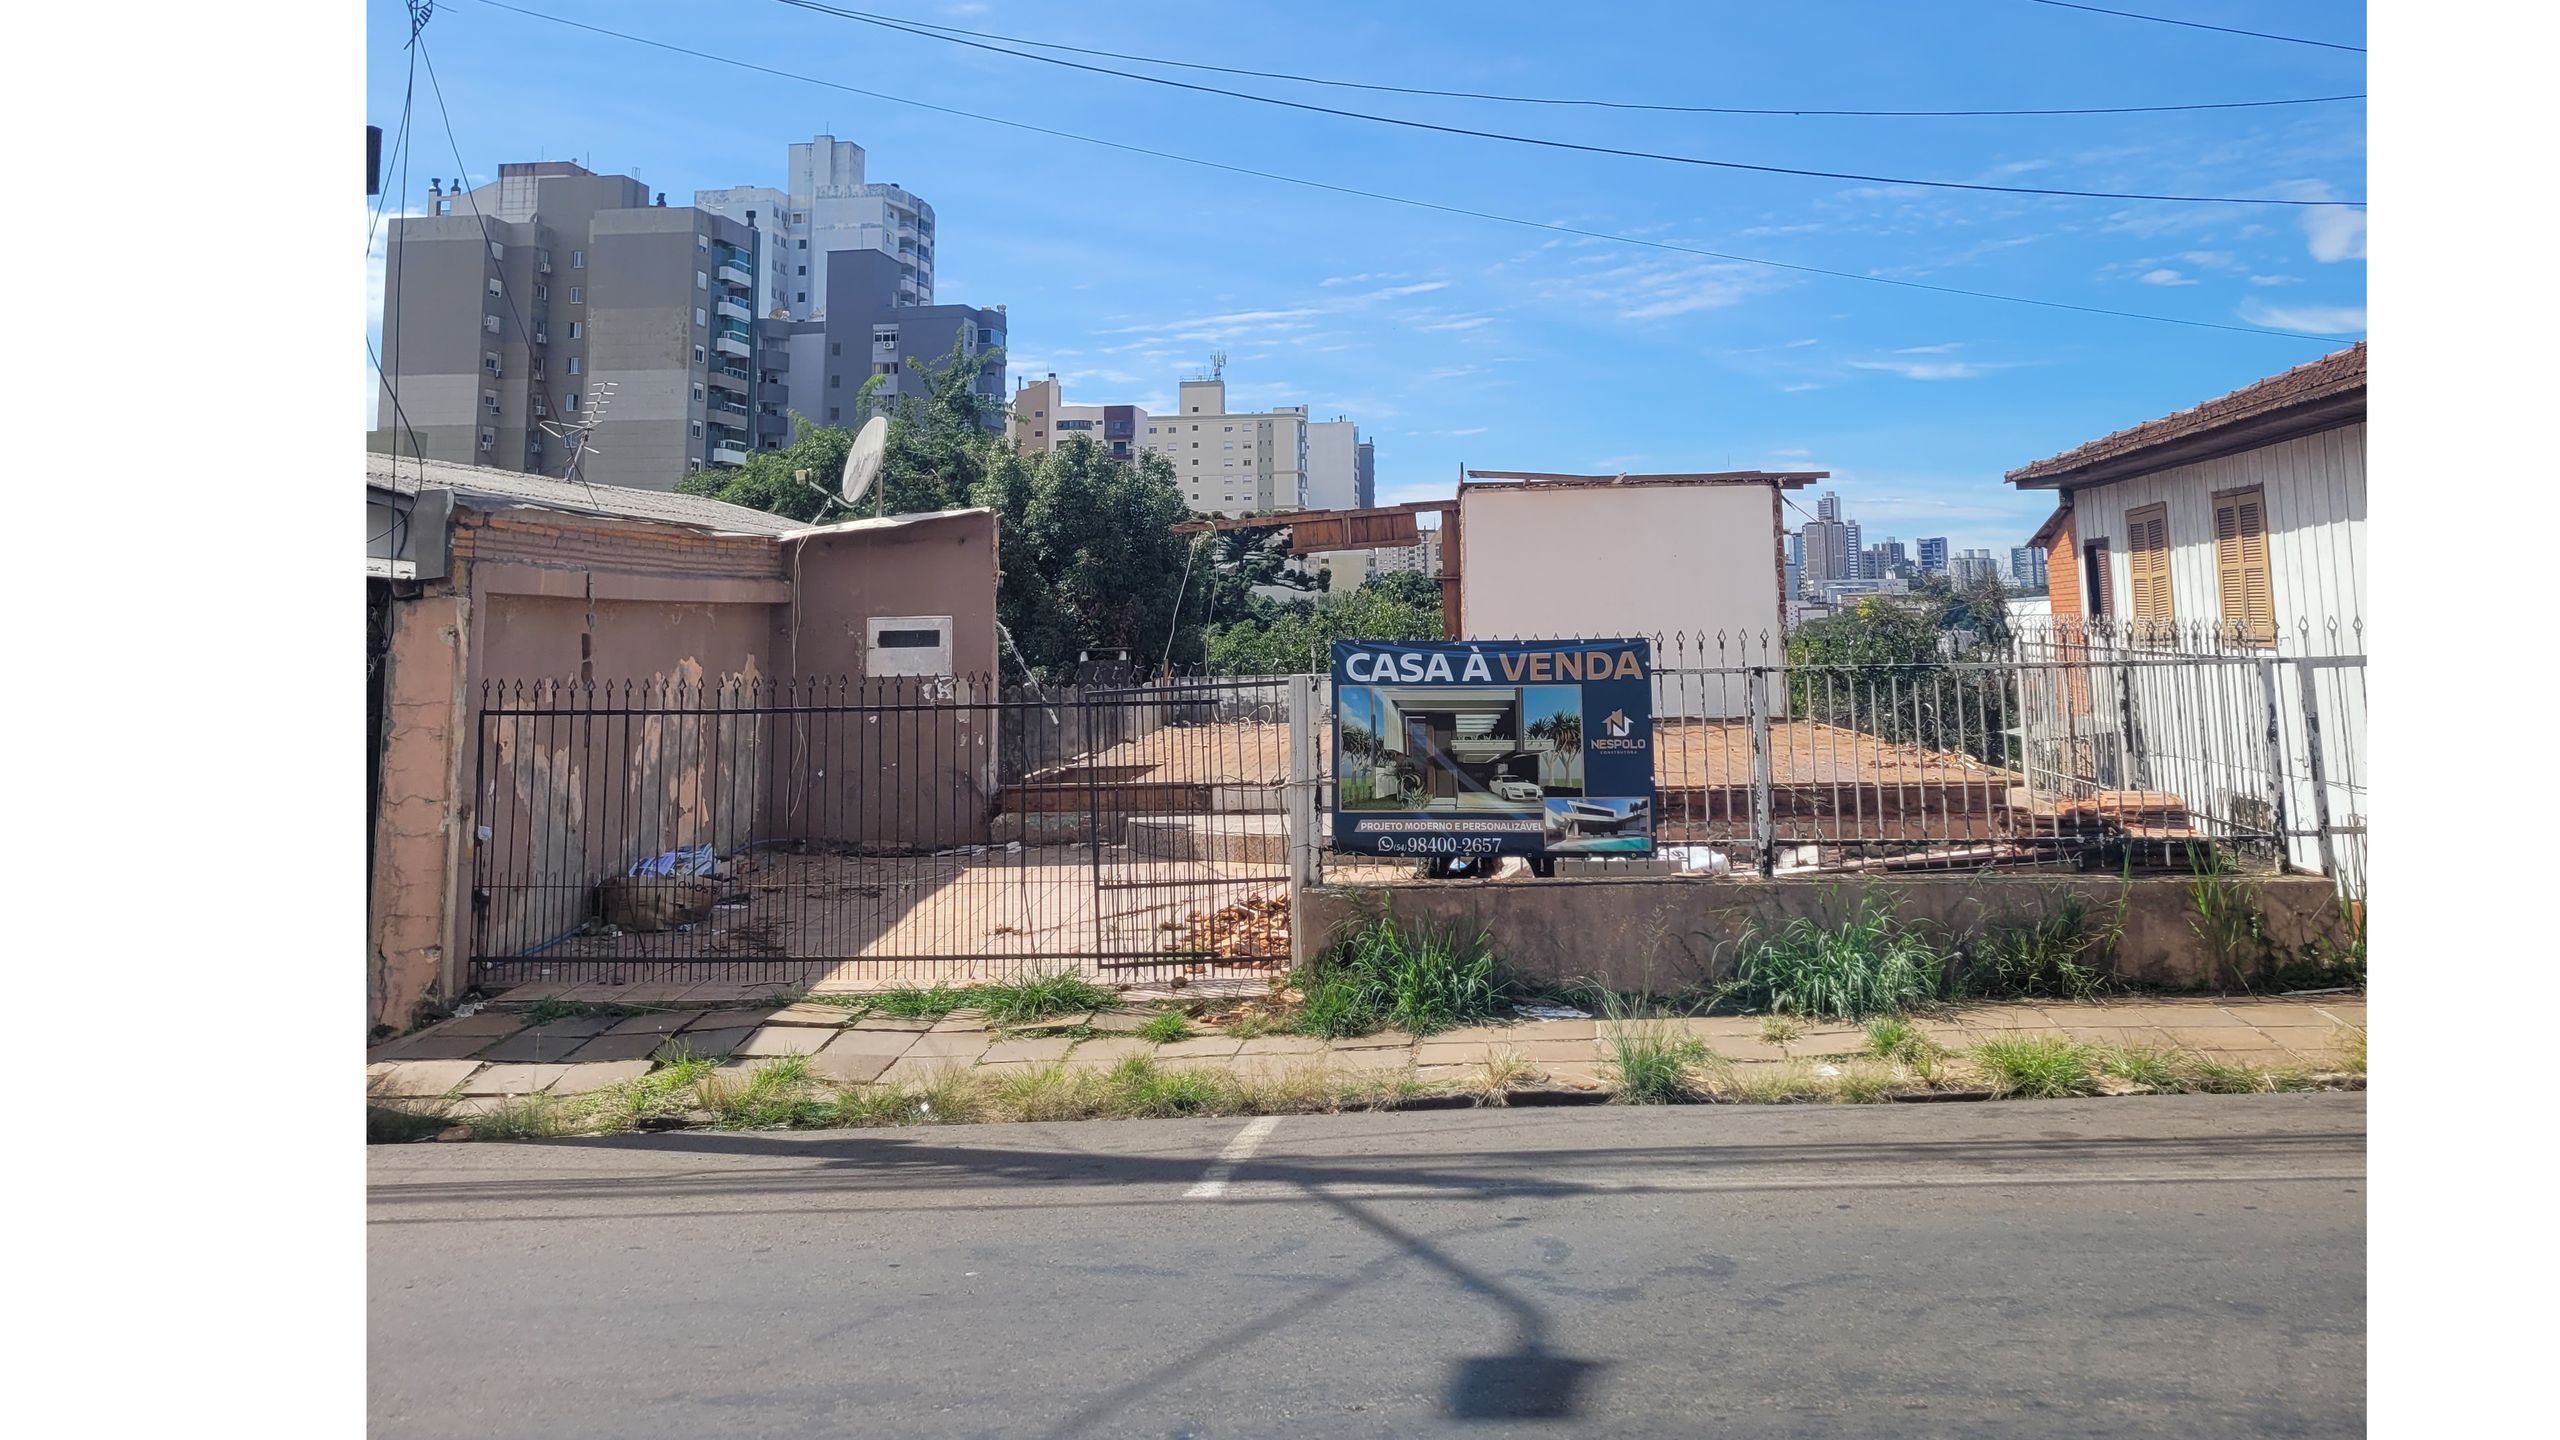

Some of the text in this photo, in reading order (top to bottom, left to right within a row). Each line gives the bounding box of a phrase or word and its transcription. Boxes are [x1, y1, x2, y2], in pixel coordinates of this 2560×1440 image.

[1345, 645, 1644, 682] CASA À VENDA
[1590, 738, 1646, 750] NESPOLO
[1361, 820, 1544, 831] PROJETO MODERNO E PERSONALIZÁVEL
[1407, 837, 1502, 853] 98400-2657
